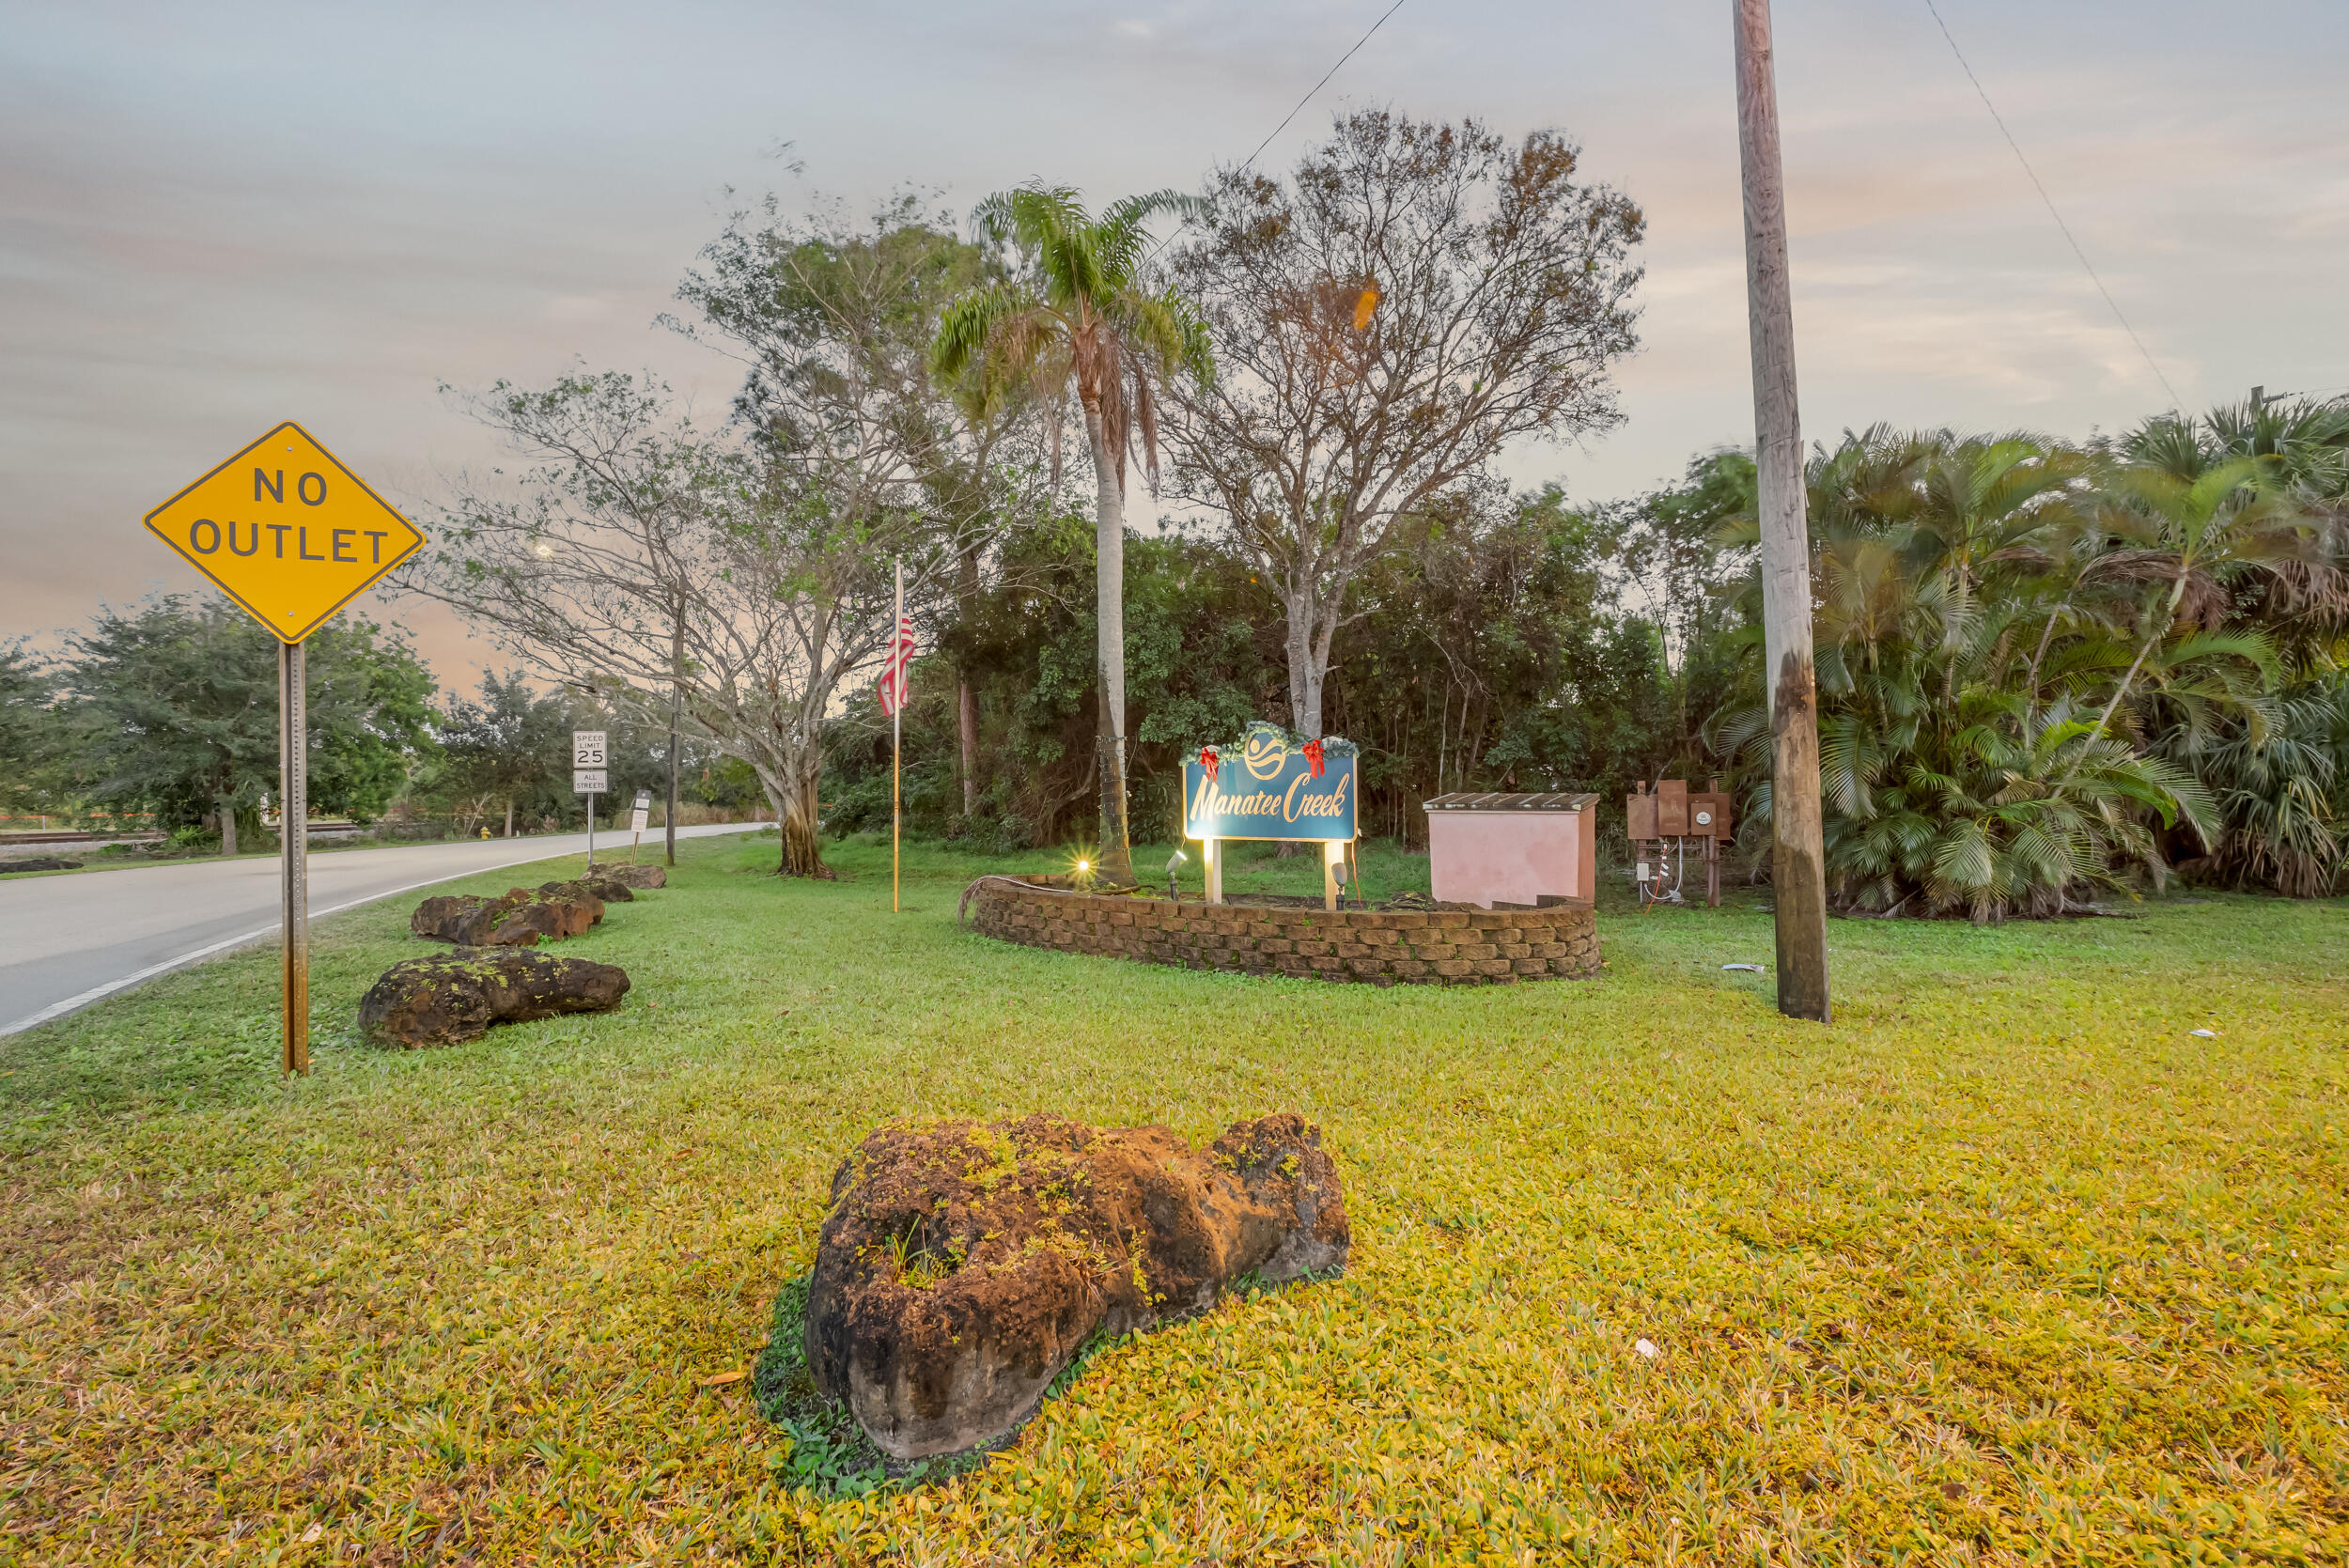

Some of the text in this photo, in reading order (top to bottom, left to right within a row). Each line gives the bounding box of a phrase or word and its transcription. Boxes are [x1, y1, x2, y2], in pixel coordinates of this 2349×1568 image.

[254, 467, 327, 506] NO
[189, 519, 388, 564] OUTLET
[577, 750, 603, 763] 25
[1190, 772, 1350, 823] Manatee Creek
